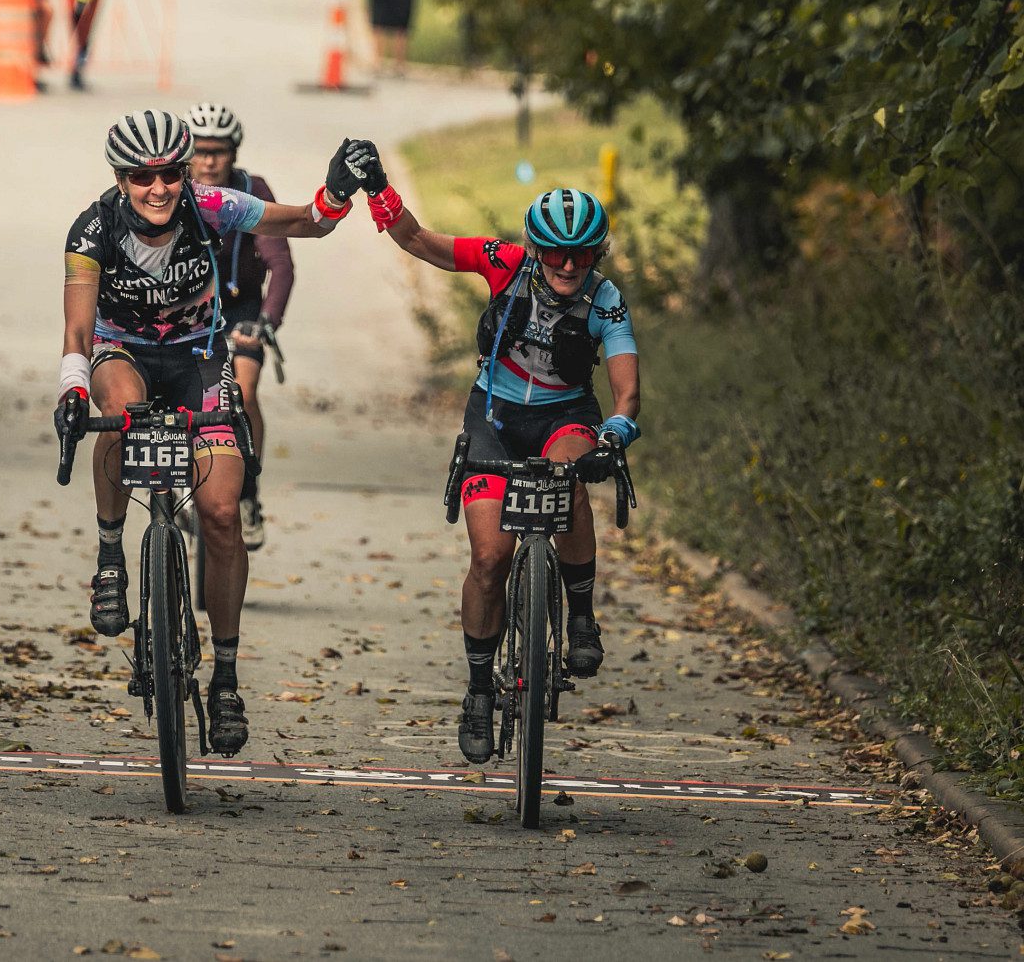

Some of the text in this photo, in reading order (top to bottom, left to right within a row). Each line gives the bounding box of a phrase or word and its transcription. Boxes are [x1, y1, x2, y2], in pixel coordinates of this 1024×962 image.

[188, 281, 205, 294] TENN
[163, 431, 187, 441] SUGAR
[124, 445, 189, 467] 1162
[506, 492, 571, 513] 1163
